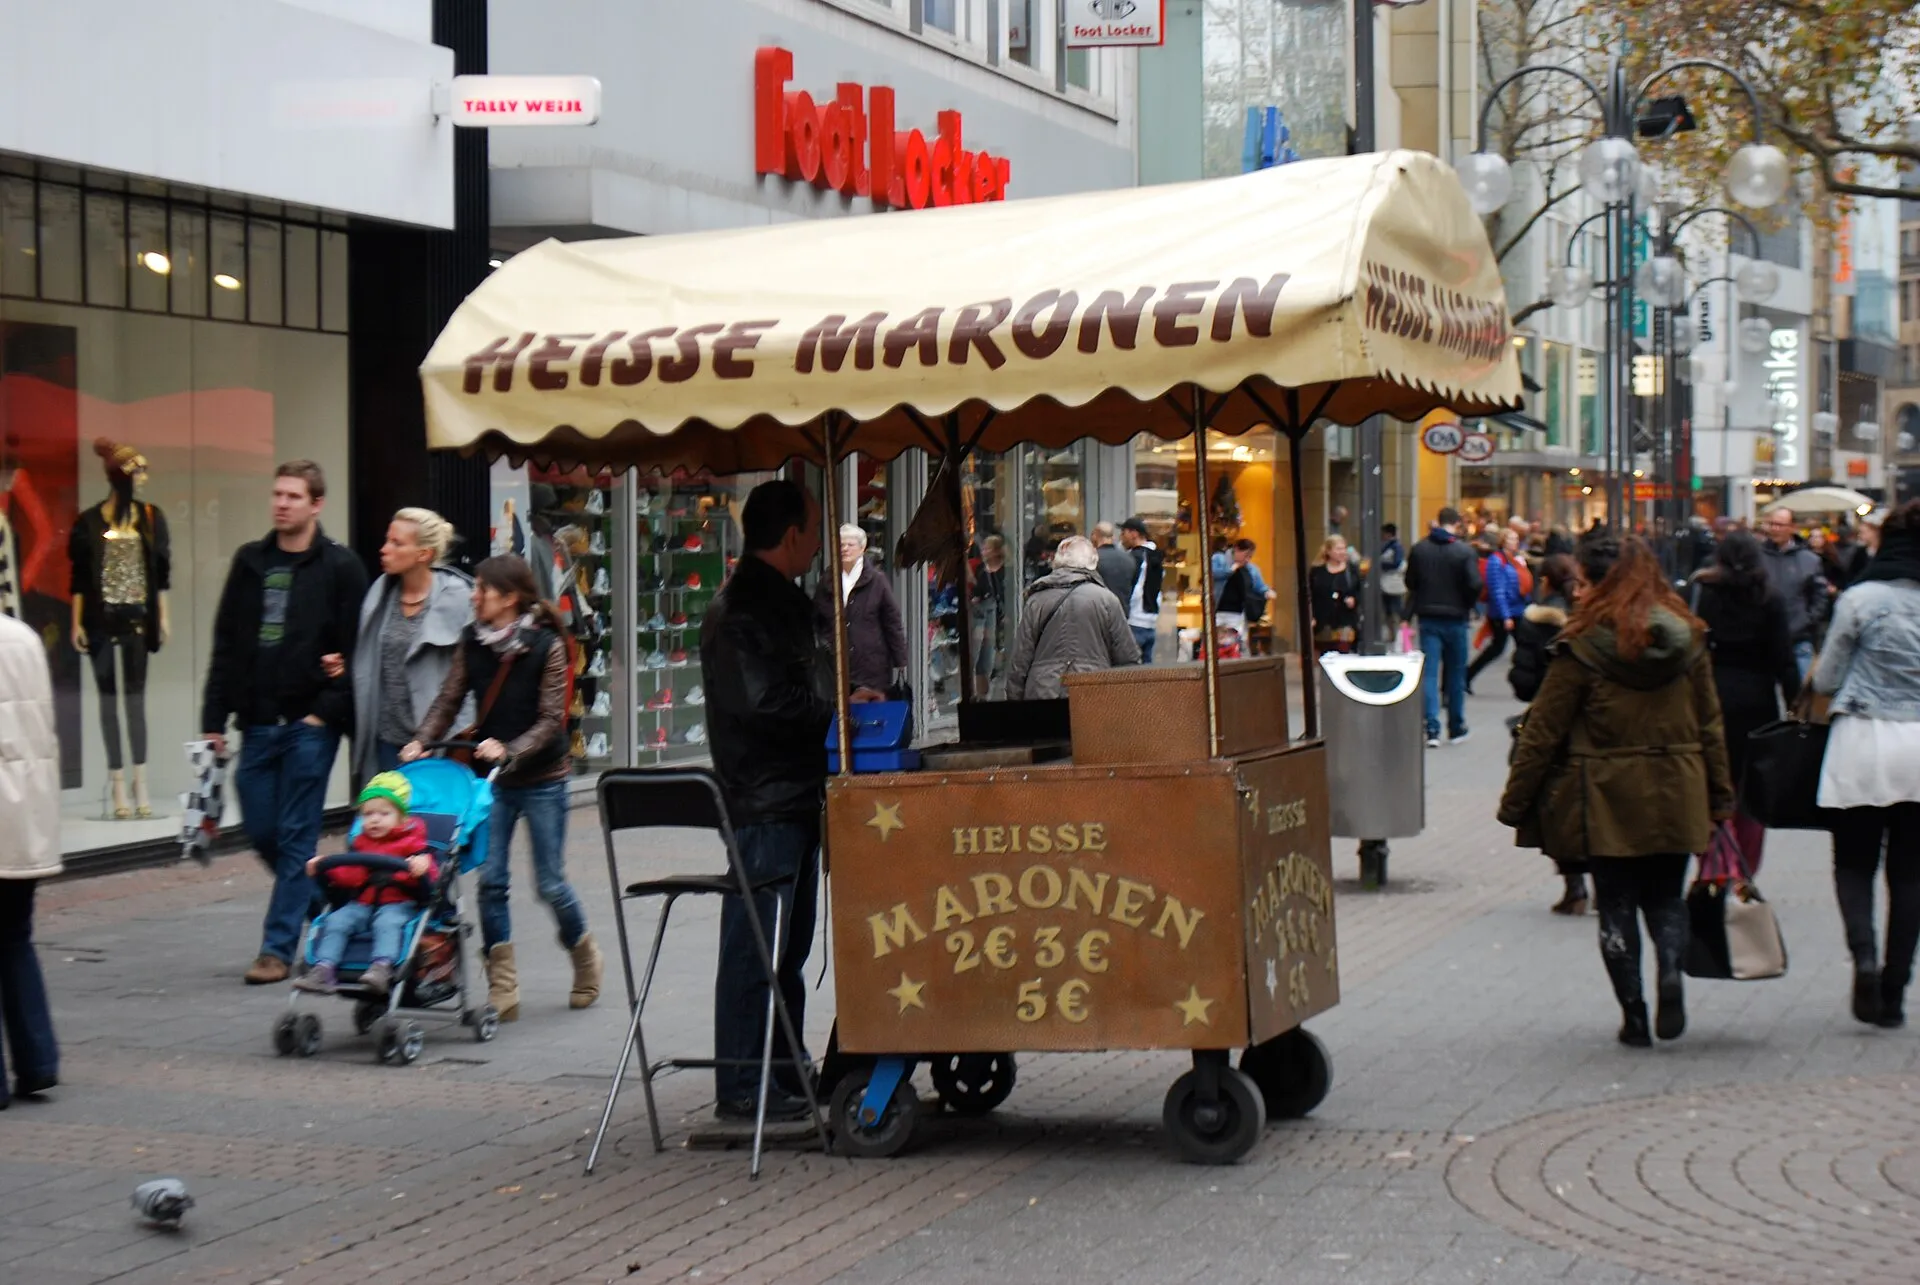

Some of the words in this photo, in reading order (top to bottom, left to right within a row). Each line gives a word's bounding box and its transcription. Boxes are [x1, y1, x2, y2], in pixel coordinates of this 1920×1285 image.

[1074, 25, 1102, 37] Foot
[1107, 24, 1152, 37] Locker
[463, 99, 518, 113] TALLY
[461, 319, 781, 395] HEISSE
[794, 273, 1292, 375] MARONEN
[952, 822, 1108, 856] HEISSE
[866, 864, 1205, 959] MARONEN
